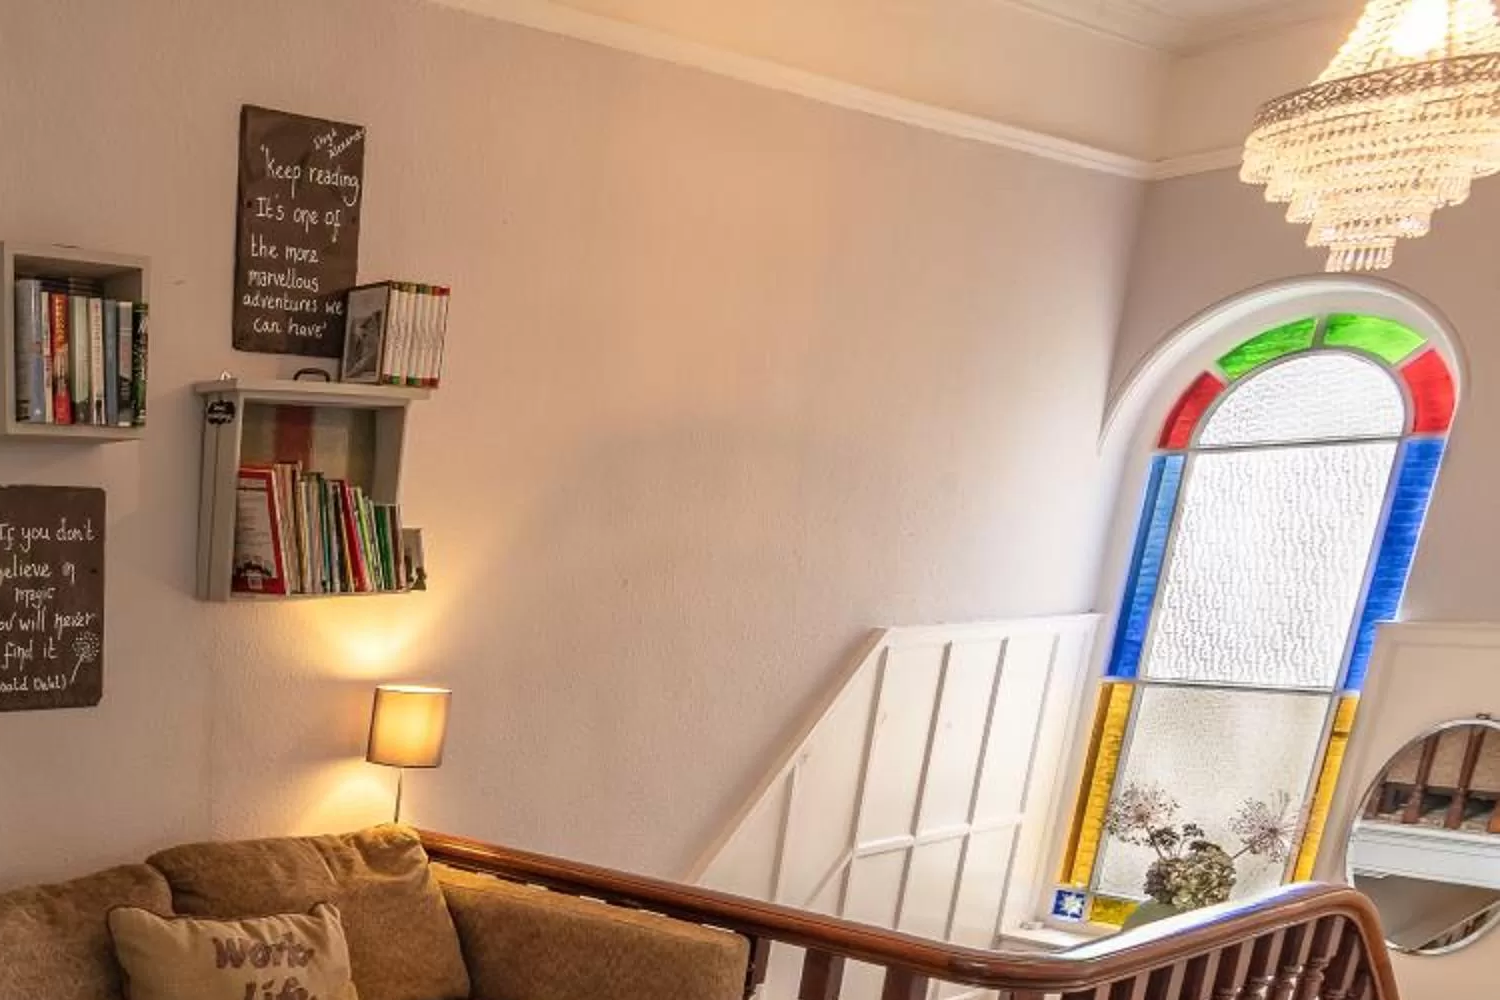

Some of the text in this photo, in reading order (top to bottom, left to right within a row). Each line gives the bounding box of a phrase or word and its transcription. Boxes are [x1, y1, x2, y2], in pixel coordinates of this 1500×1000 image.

[310, 165, 359, 207] reading
[256, 194, 341, 243] It's one of
[251, 233, 279, 259] the
[248, 267, 319, 293] marvellous
[243, 291, 344, 317] adventures we
[253, 317, 281, 334] can
[20, 527, 50, 552] you
[56, 517, 96, 541] don't
[19, 605, 46, 632] will
[55, 611, 97, 641] never
[1, 637, 59, 672] find it
[212, 932, 315, 969] Work
